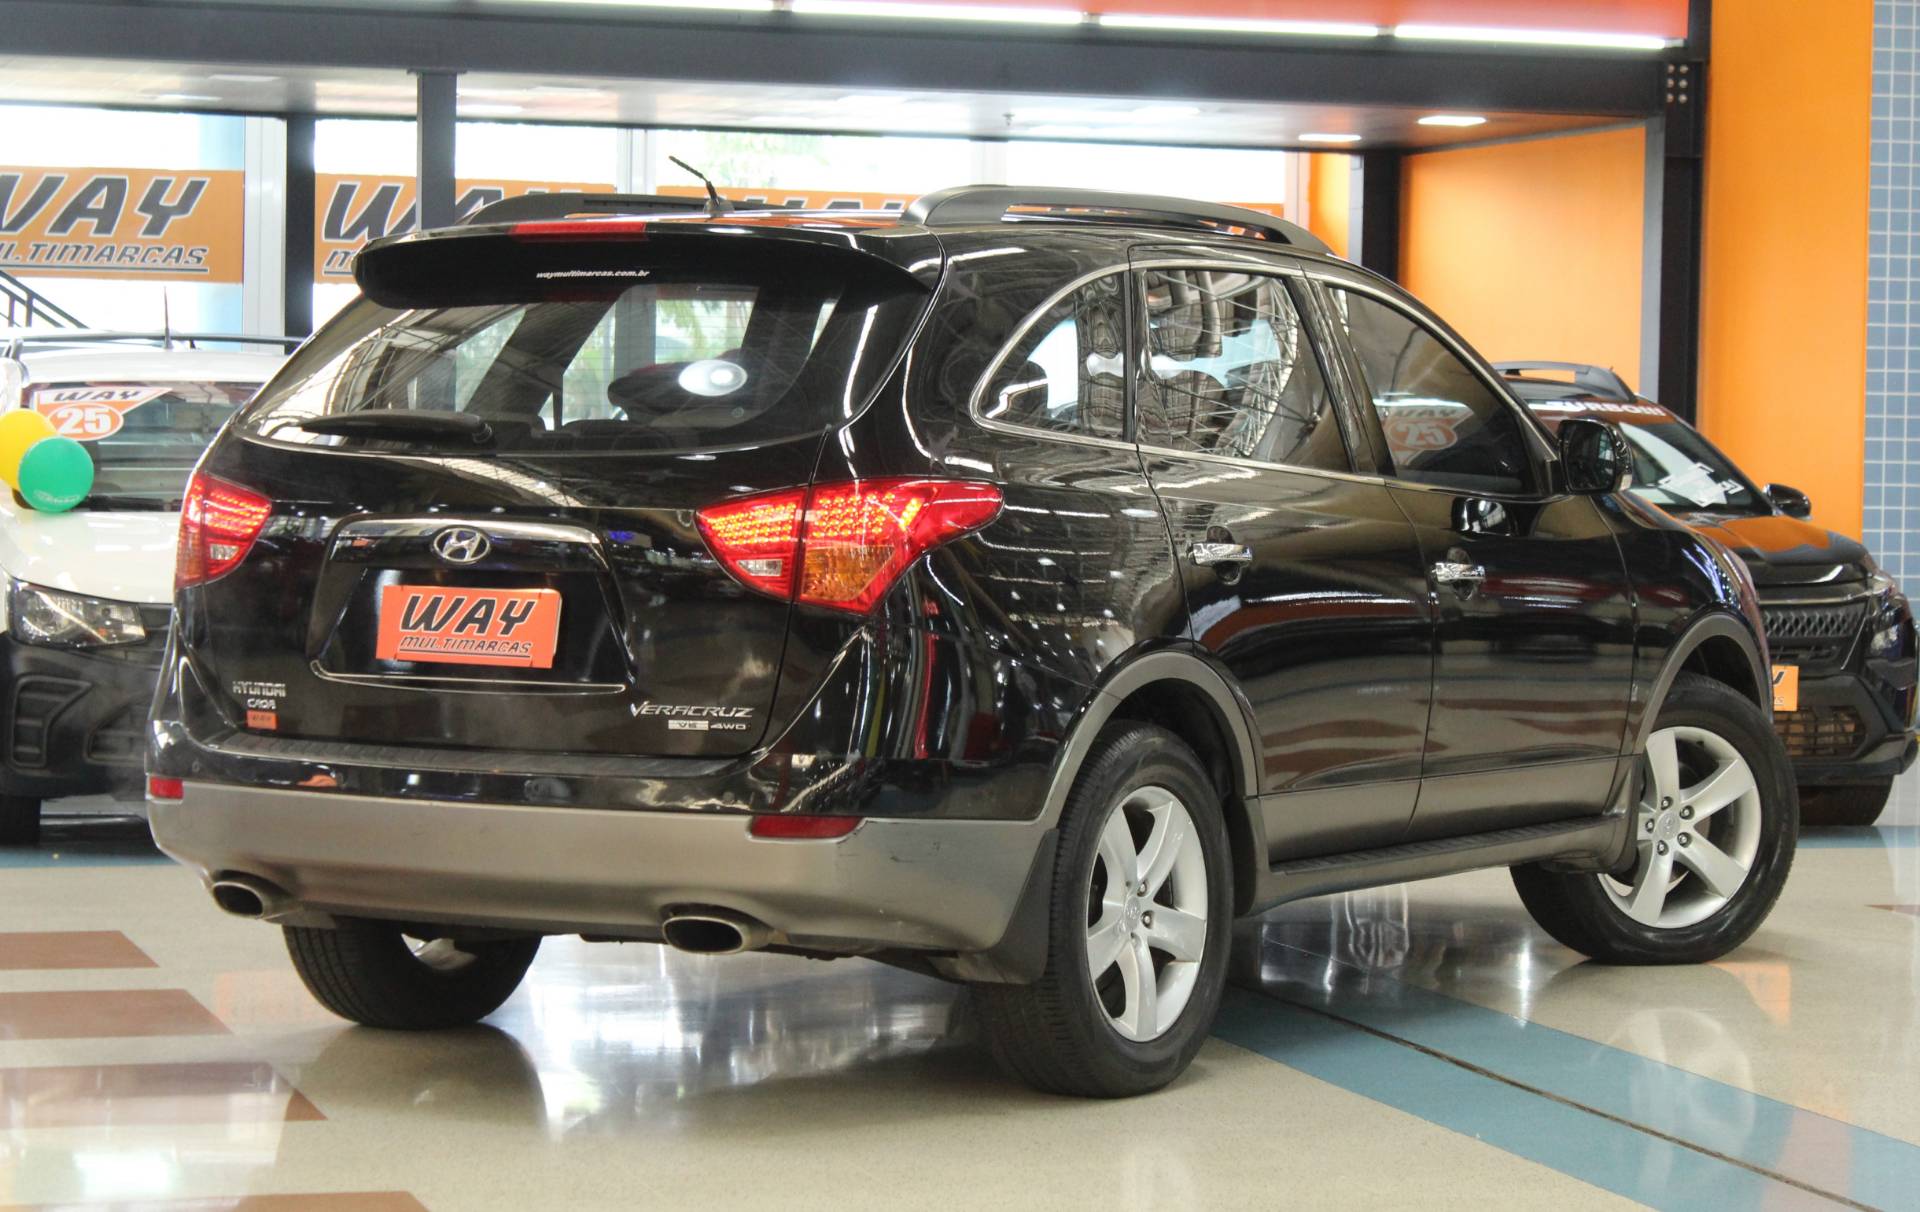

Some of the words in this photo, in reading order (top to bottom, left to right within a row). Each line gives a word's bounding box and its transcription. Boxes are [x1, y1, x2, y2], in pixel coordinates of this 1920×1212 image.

[0, 243, 209, 264] LTIMARCAS
[536, 270, 650, 279] waymultimarcas.com.br
[53, 390, 141, 402] WAY
[56, 407, 112, 434] 25
[400, 594, 538, 637] WAY
[400, 636, 532, 653] MULTIMARCAS
[630, 700, 755, 718] VERACRUZ
[710, 722, 746, 730] 4WD
